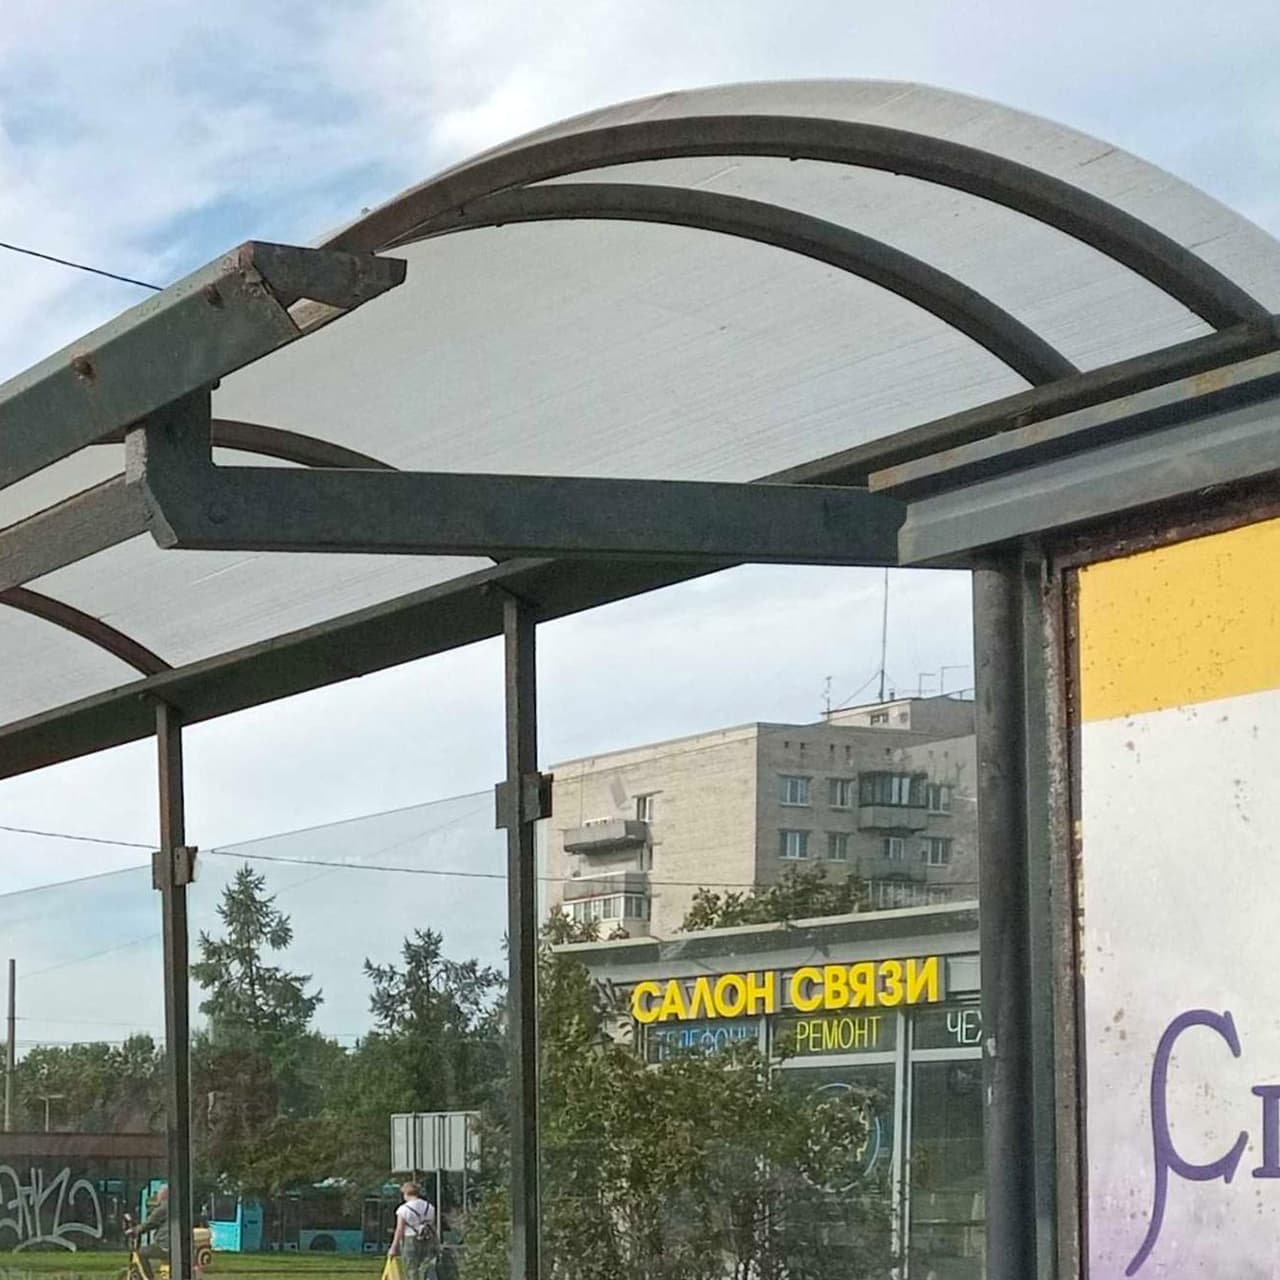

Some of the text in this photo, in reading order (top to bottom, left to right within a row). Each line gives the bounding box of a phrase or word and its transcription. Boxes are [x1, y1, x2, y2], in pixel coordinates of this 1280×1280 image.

[632, 957, 940, 1023] САЛОН СВЯЗИ
[797, 1016, 881, 1051] РЕМОНТ
